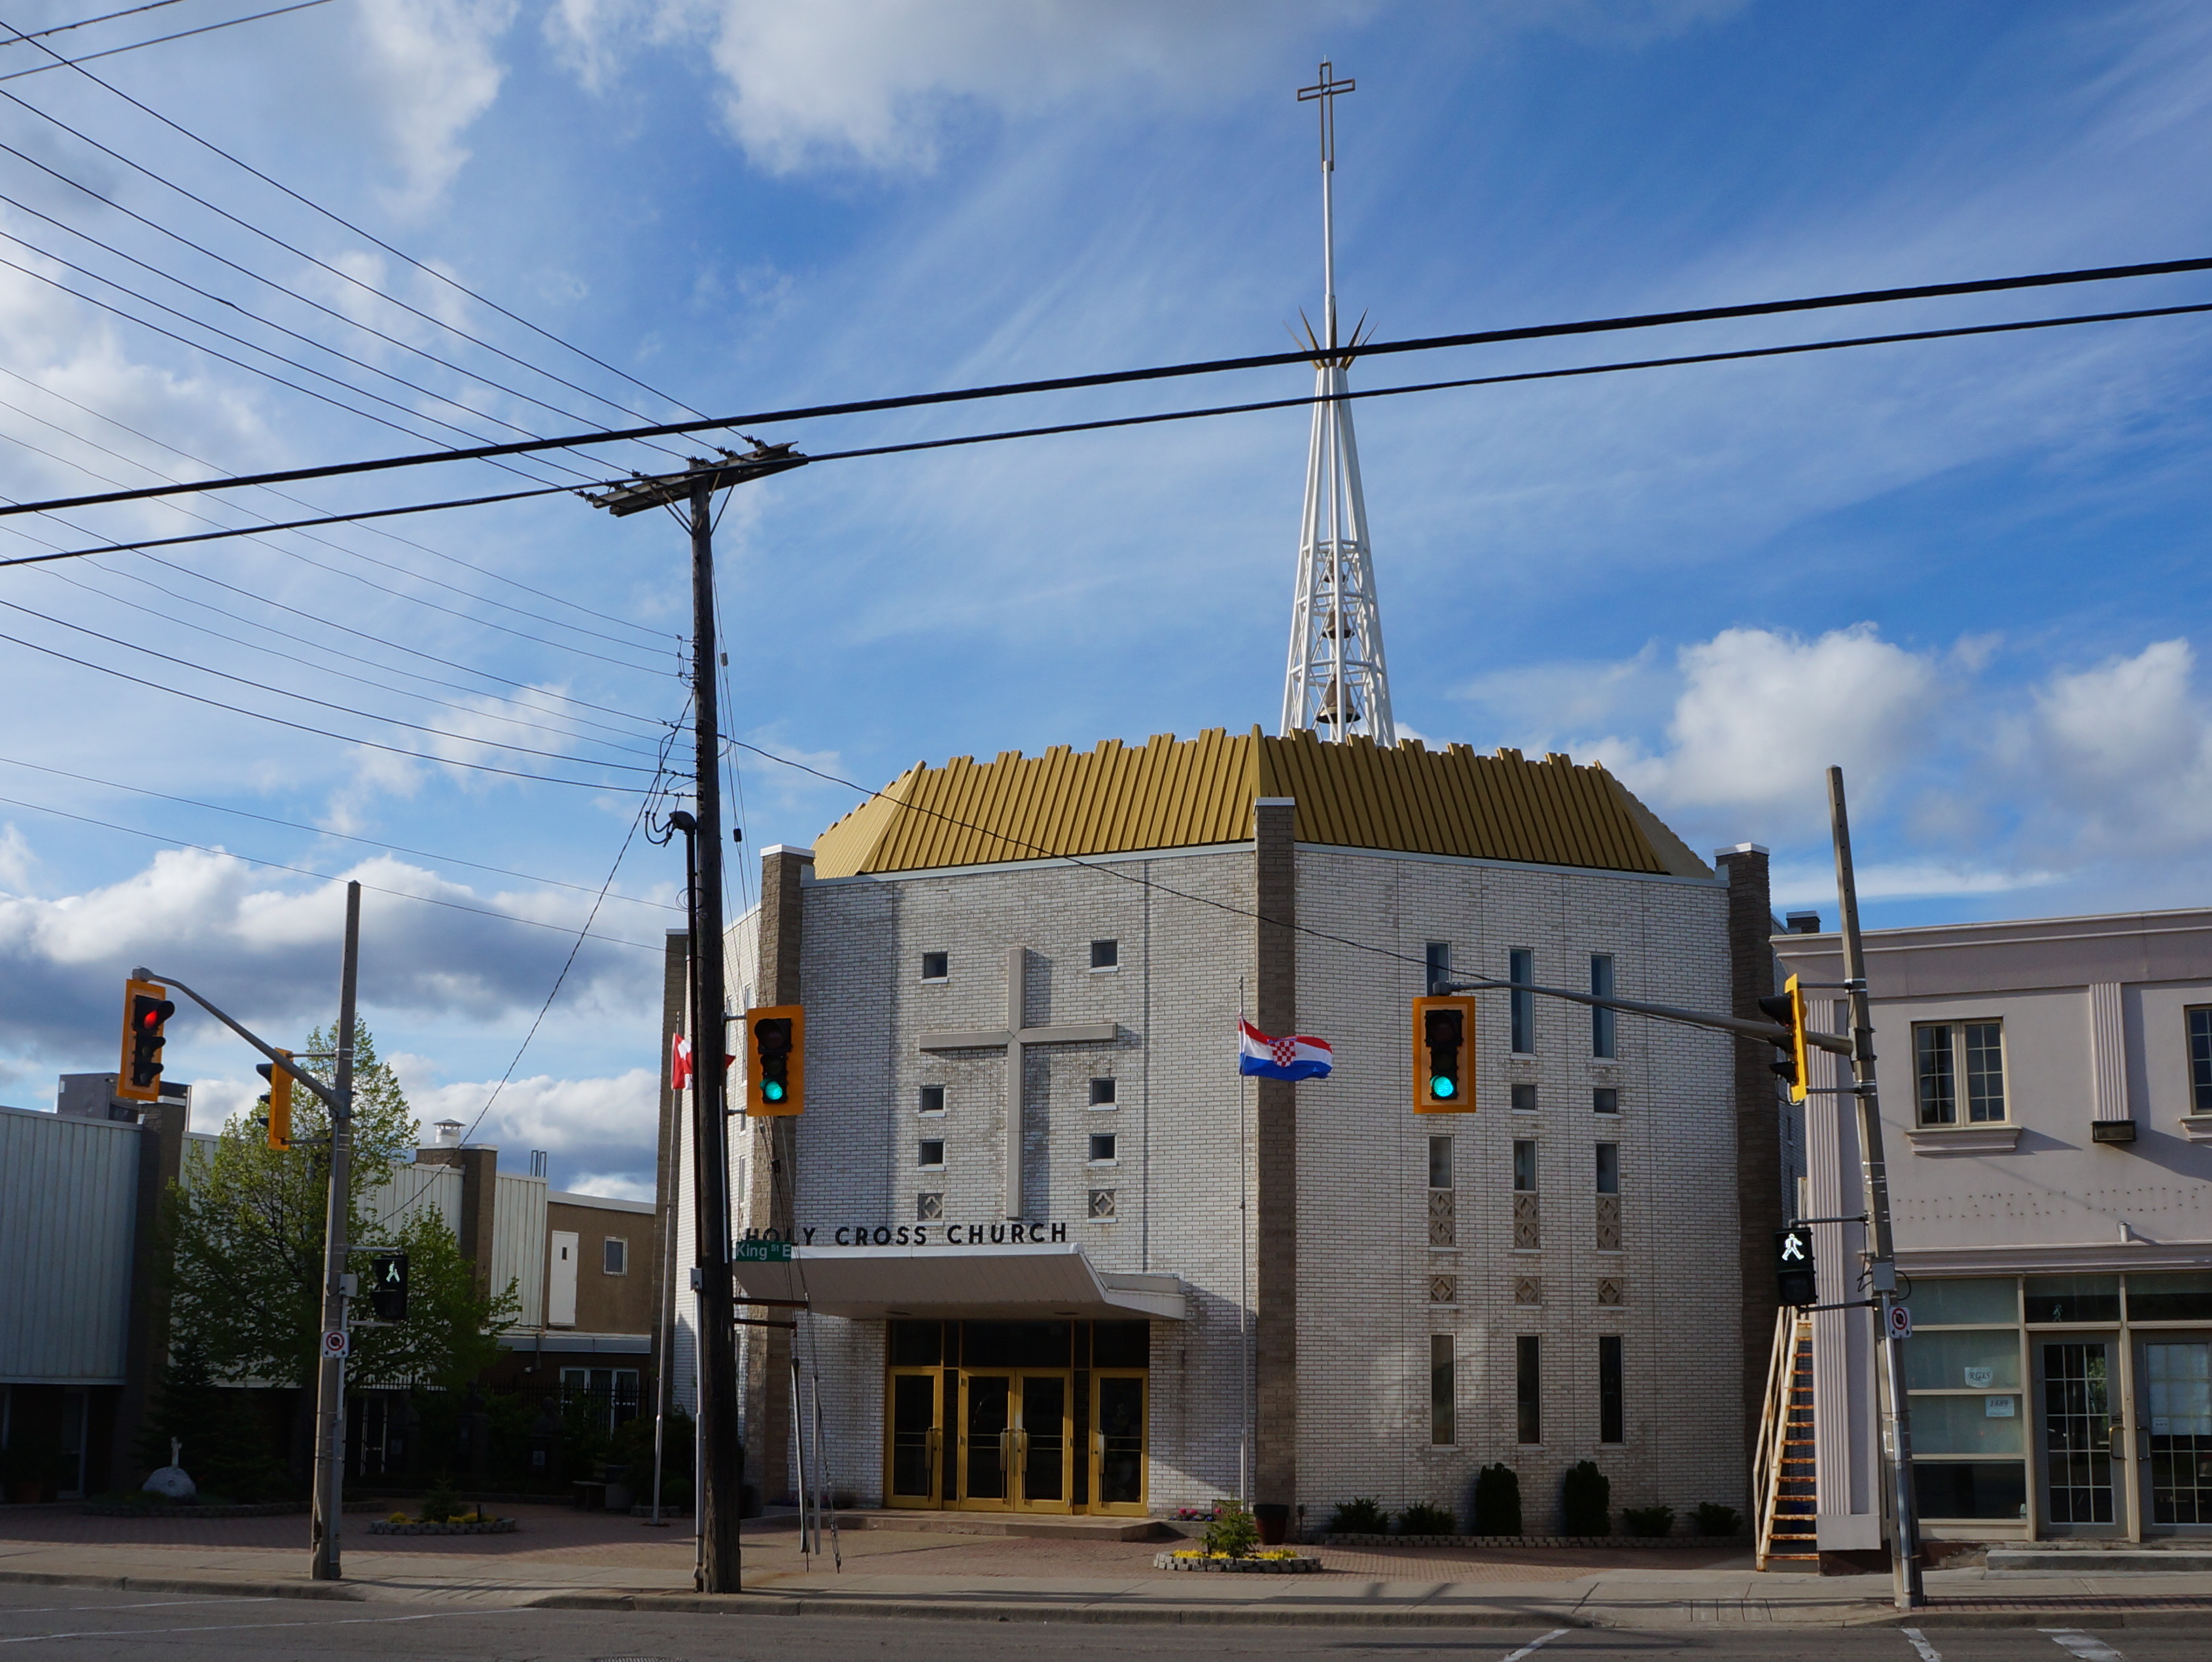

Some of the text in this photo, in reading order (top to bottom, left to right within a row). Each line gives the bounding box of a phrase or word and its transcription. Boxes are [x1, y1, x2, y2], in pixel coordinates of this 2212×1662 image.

[835, 1226, 926, 1246] CROSS
[947, 1222, 1066, 1244] CHURCH
[737, 1244, 767, 1260] King
[782, 1244, 791, 1257] E
